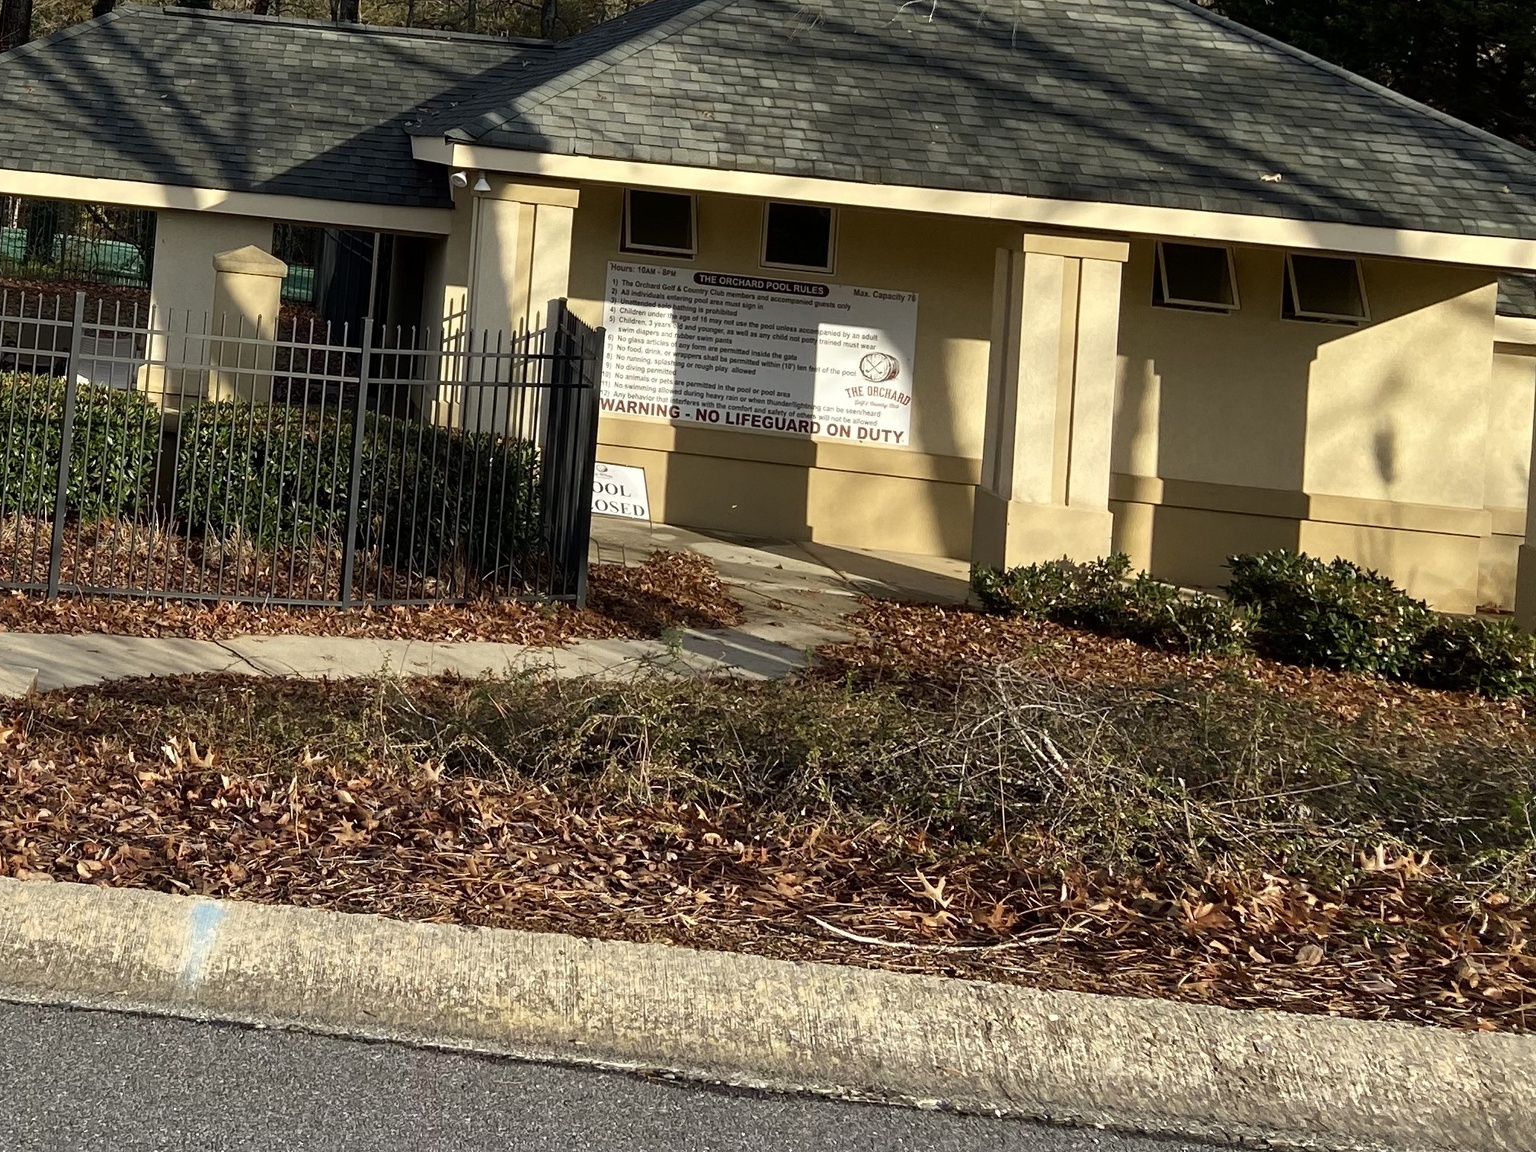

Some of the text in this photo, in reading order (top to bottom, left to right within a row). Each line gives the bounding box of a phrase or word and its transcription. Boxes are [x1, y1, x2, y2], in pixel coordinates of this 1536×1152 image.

[611, 263, 635, 272] Hours:
[700, 275, 824, 295] THE ORCHARD POOL RULES
[622, 279, 633, 287] The
[635, 281, 660, 289] Orchard
[683, 286, 709, 296] Country
[726, 292, 755, 300] members
[771, 297, 813, 305] accompanied
[837, 303, 851, 311] only
[631, 291, 665, 299] individuals
[667, 295, 693, 304] entering
[873, 291, 905, 302] Capacity
[673, 304, 696, 313] bathing
[709, 318, 722, 326] may
[799, 328, 840, 336] accompanied
[675, 332, 695, 340] rubber
[729, 358, 760, 366] permitted
[626, 365, 645, 373] diving
[647, 368, 677, 376] permitted
[715, 365, 728, 373] play
[732, 367, 756, 375] allowed
[684, 390, 704, 399] during
[706, 392, 724, 401] heavy
[845, 386, 864, 398] THE
[868, 386, 911, 405] ORCHARD
[613, 391, 626, 399] Any
[627, 393, 655, 401] behavior
[768, 409, 787, 417] safety
[601, 399, 680, 418] WARNING
[696, 409, 720, 423] NO
[726, 413, 820, 433] LIFEGUARD
[827, 424, 851, 438] ON
[858, 427, 904, 443] DUTY
[593, 481, 632, 497] OOL
[593, 499, 645, 517] OSED
